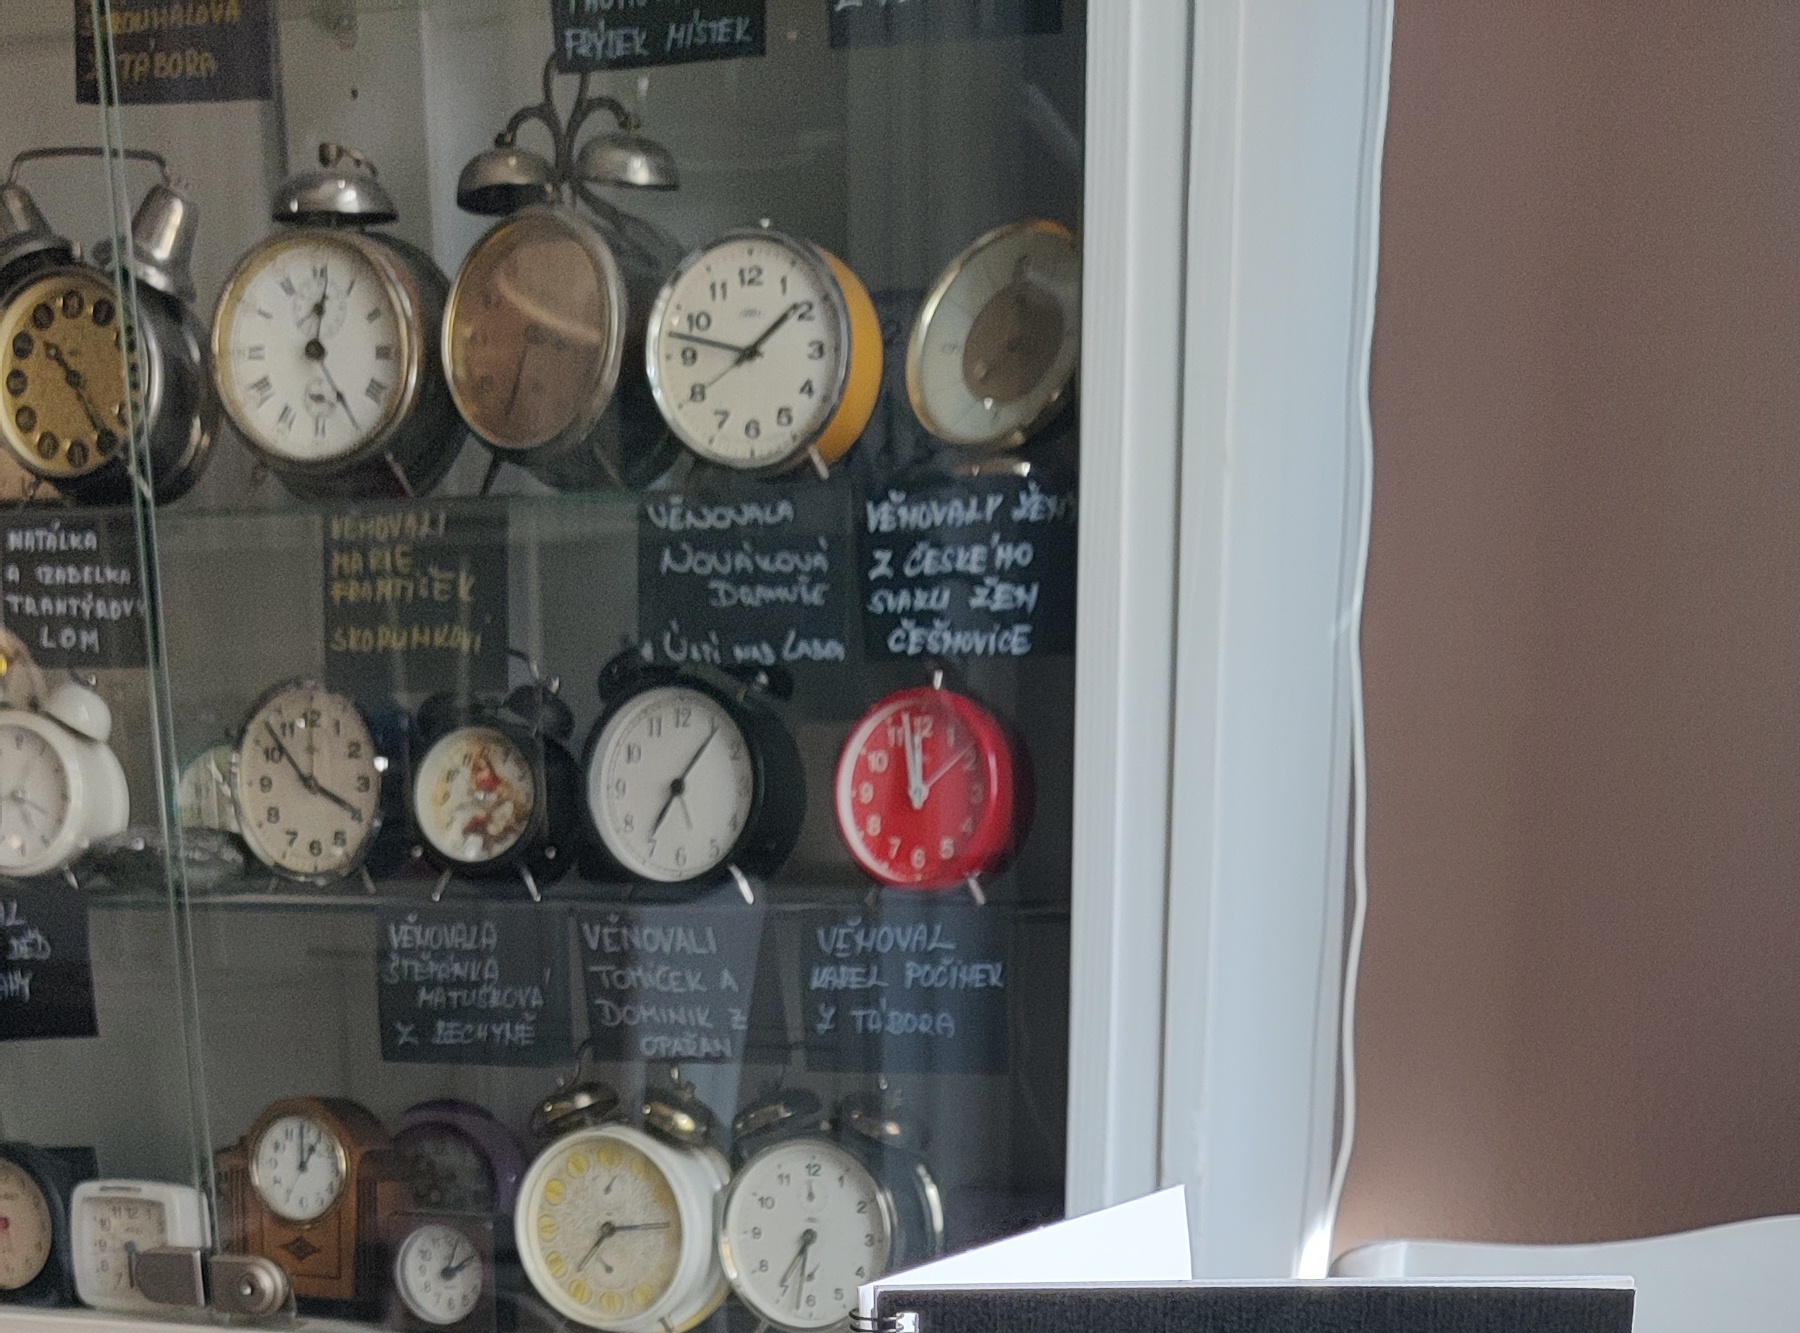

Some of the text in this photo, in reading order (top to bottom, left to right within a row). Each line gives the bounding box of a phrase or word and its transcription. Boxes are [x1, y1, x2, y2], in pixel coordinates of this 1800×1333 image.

[738, 265, 763, 288] 12
[780, 275, 787, 295] 1
[709, 281, 728, 301] 11
[797, 301, 815, 321] 2
[686, 311, 711, 332] 10
[681, 347, 697, 366] 9
[807, 340, 825, 360] 3
[690, 383, 706, 402] 8
[800, 379, 814, 399] 4
[714, 409, 730, 430] 7
[776, 407, 793, 426] 5
[744, 419, 760, 439] 6
[866, 488, 1004, 534] VĚNOVALY
[7, 519, 98, 554] NATÁLKA
[330, 544, 414, 576] MARIE
[867, 550, 894, 581] Z
[6, 562, 20, 584] A
[968, 575, 1040, 616] ŽEN
[40, 624, 100, 653] LOM
[650, 717, 662, 738] 11
[674, 707, 692, 728] 12
[280, 721, 295, 738] 11
[348, 742, 361, 759] 2
[626, 743, 641, 764] 10
[867, 749, 889, 773] 10
[260, 775, 272, 793] 9
[356, 775, 370, 793] 3
[615, 778, 626, 799] 9
[859, 781, 874, 805] 9
[267, 806, 280, 824] 8
[624, 814, 634, 833] 8
[867, 813, 882, 837] 8
[286, 830, 298, 847] 7
[309, 839, 322, 857] 6
[334, 830, 347, 847] 5
[709, 838, 720, 858] 5
[888, 837, 901, 859] 7
[939, 836, 955, 860] 5
[648, 839, 657, 859] 7
[675, 847, 687, 867] 6
[911, 848, 926, 870] 6
[581, 913, 718, 954] VĚNOVALI
[816, 914, 957, 958] VĚNOVAL
[719, 967, 739, 993] A
[595, 998, 714, 1030] DOMINIK
[851, 996, 956, 1039] TÁBORA
[778, 1173, 791, 1187] 11
[806, 1163, 822, 1177] 12
[839, 1175, 845, 1188] 1
[758, 1196, 775, 1210] 10
[857, 1201, 867, 1214] 2
[752, 1227, 762, 1240] 9
[865, 1233, 875, 1247] 3
[759, 1259, 769, 1273] 8
[856, 1266, 865, 1279] 4
[806, 1294, 816, 1307] 6
[834, 1288, 844, 1301] 5
